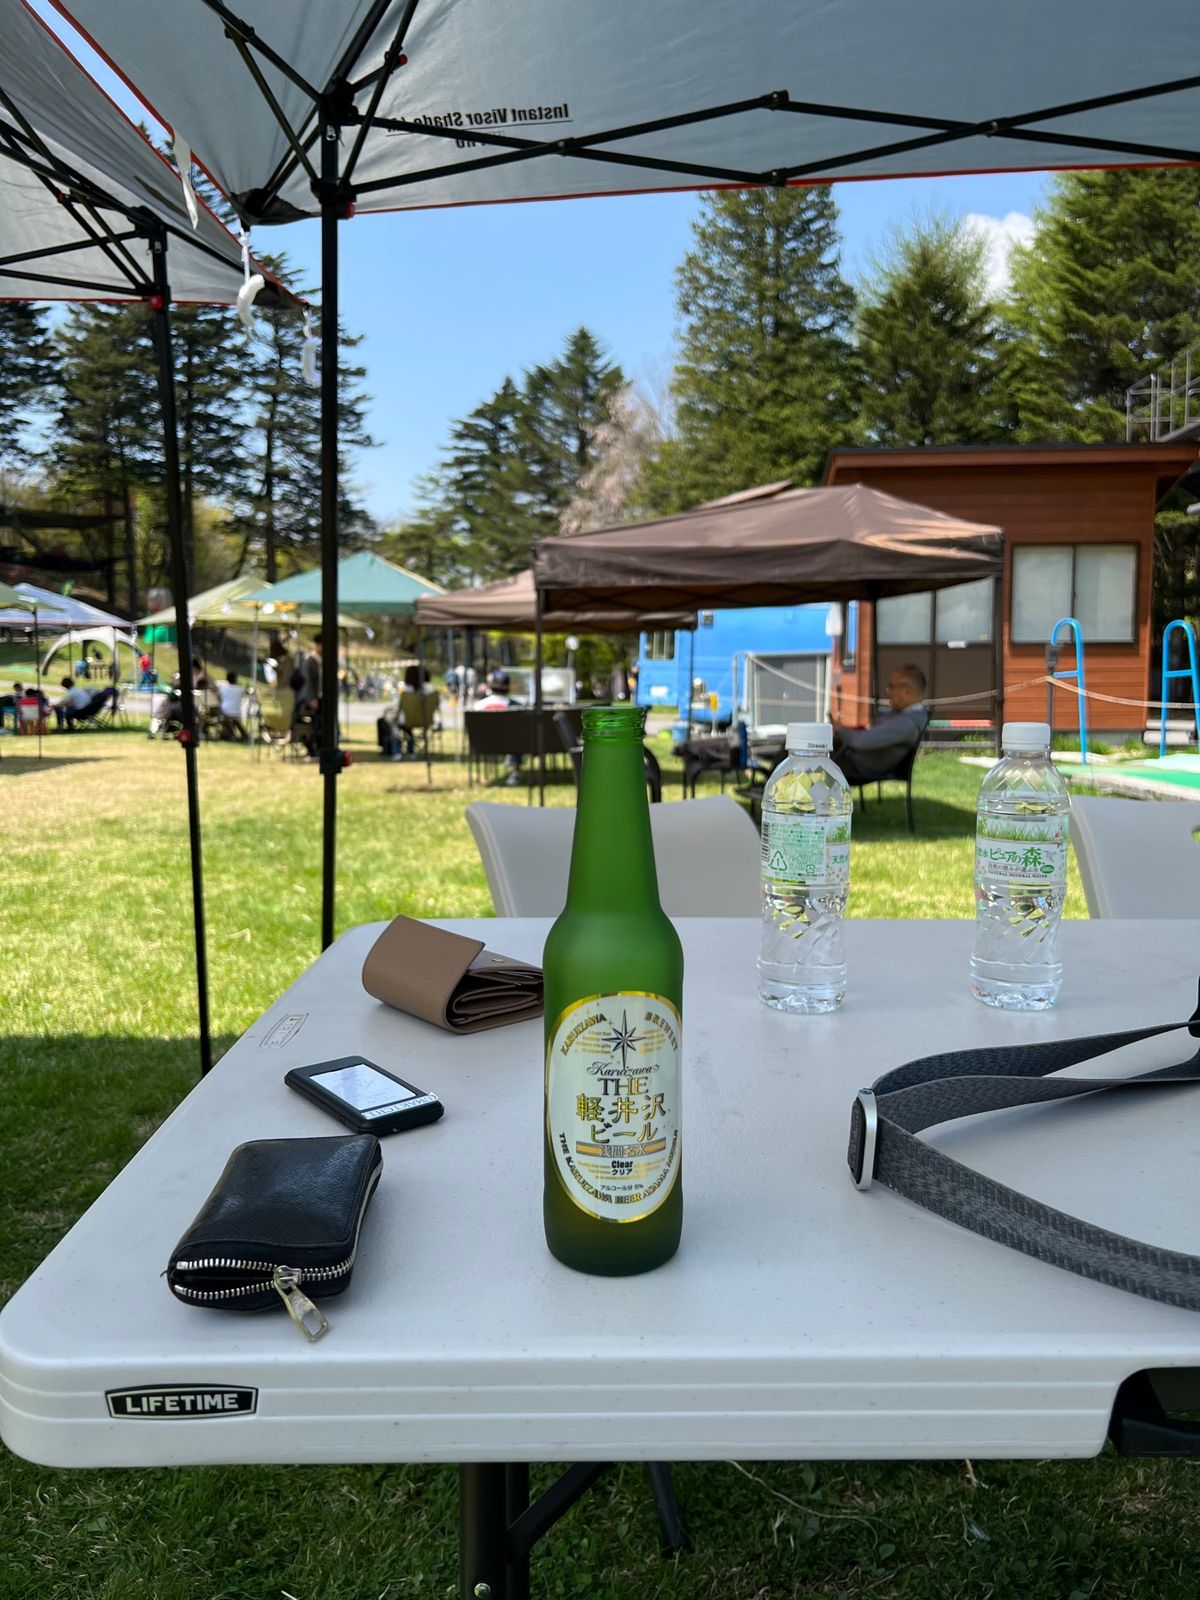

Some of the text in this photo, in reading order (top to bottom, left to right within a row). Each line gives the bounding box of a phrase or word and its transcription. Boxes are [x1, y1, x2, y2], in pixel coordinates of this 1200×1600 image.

[561, 1013, 607, 1056] KARUIZAWA
[645, 1011, 678, 1052] BREWERY
[586, 1061, 660, 1077] Karuizawa
[597, 1076, 649, 1096] THE
[576, 1093, 666, 1124] 軽井沢
[591, 1121, 658, 1144] ビール
[559, 1132, 570, 1155] THE
[566, 1156, 613, 1204] KARUIZAWA
[615, 1192, 642, 1204] BEER
[611, 1160, 634, 1169] Clear
[125, 1393, 239, 1413] LIFETIME
